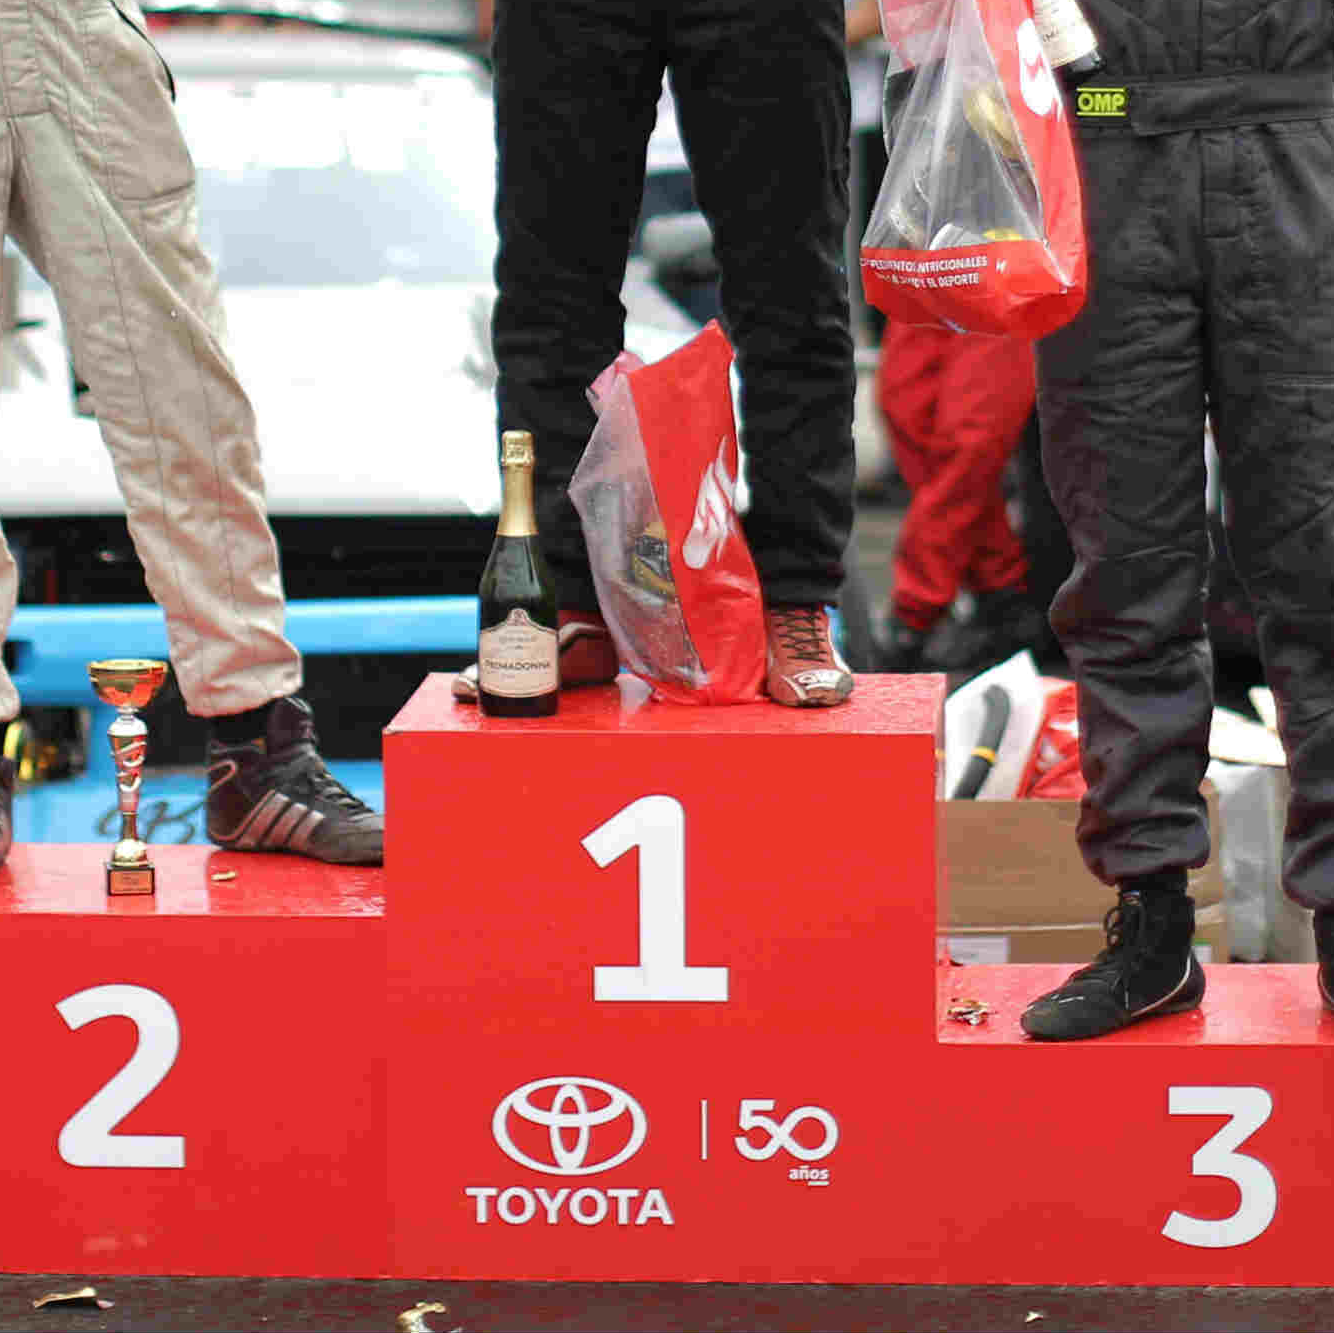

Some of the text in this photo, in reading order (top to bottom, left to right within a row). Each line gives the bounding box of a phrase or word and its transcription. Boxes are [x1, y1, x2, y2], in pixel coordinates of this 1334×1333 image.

[1077, 93, 1127, 113] OMP
[581, 795, 730, 1002] 1
[55, 984, 186, 1169] 2
[734, 1099, 839, 1162] 50
[788, 1165, 830, 1181] años
[1161, 1085, 1278, 1248] 3
[466, 1187, 674, 1226] TOYOTA
